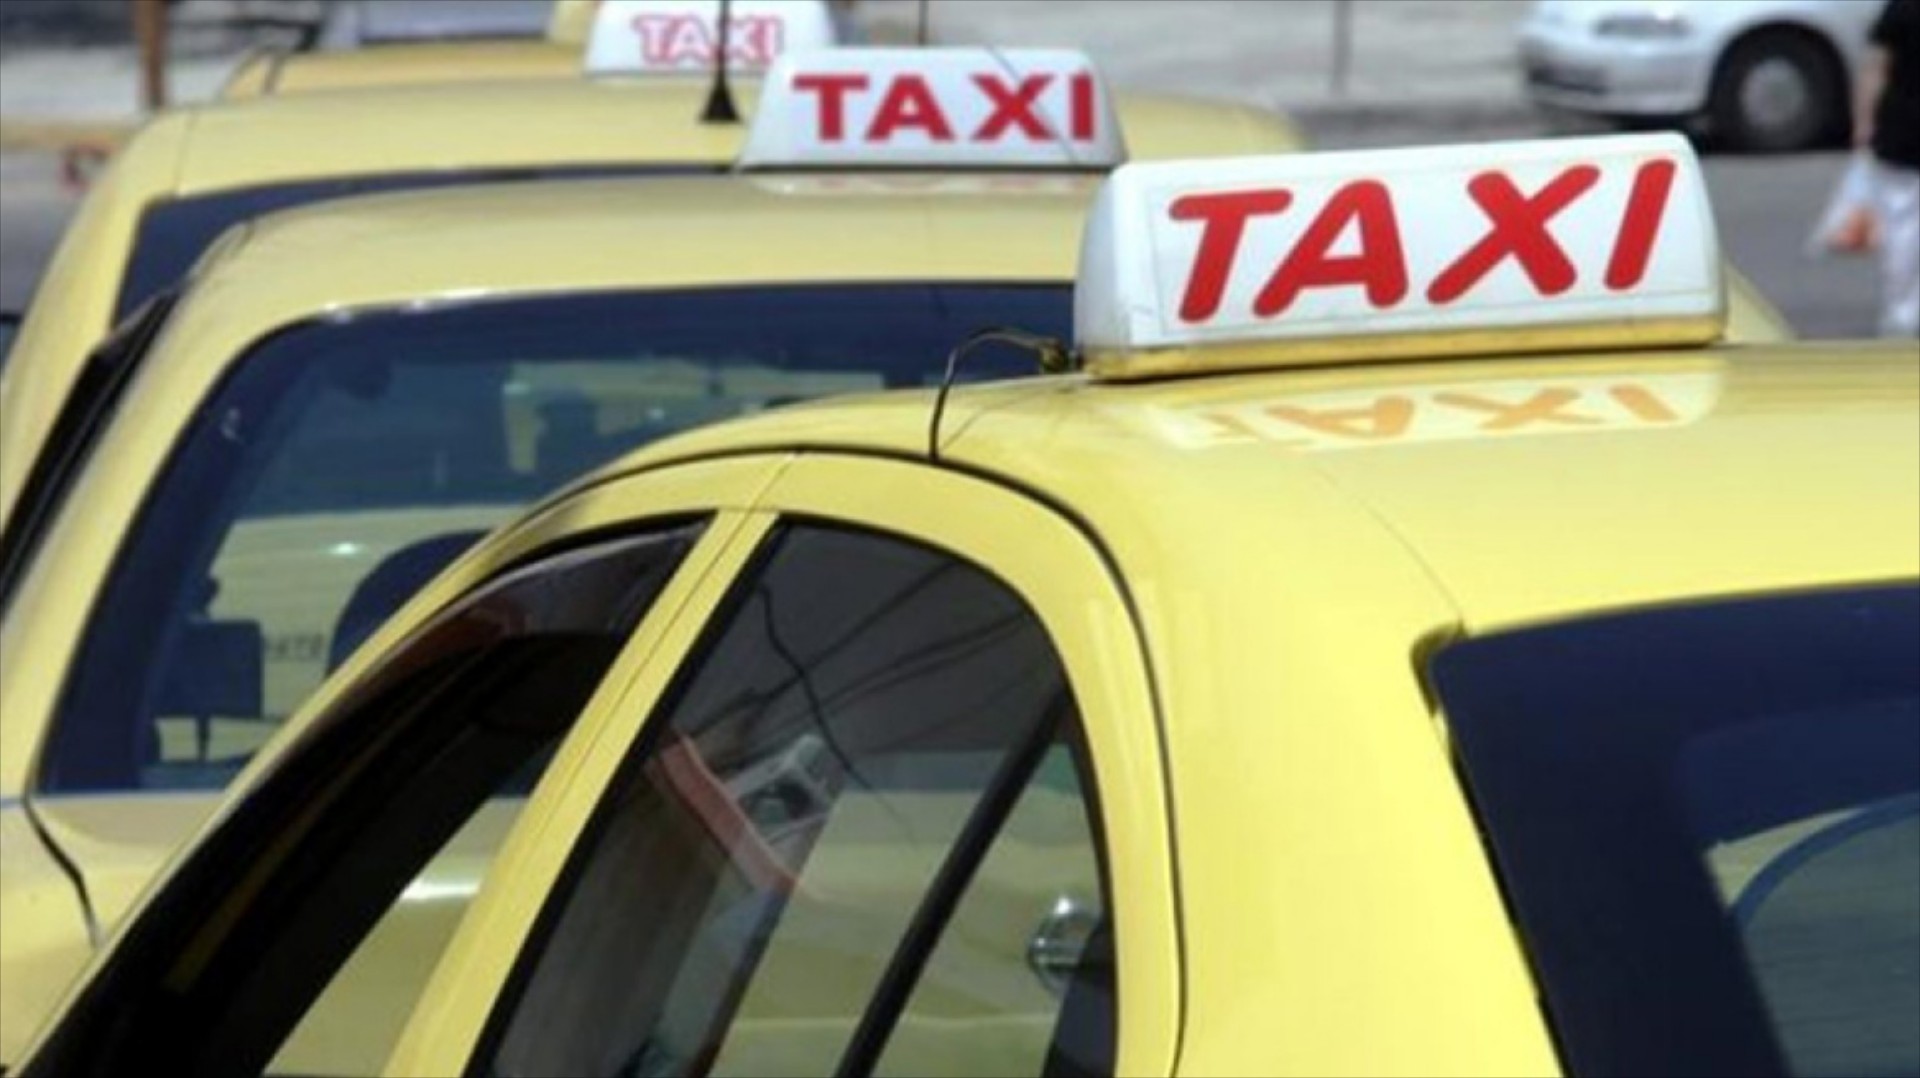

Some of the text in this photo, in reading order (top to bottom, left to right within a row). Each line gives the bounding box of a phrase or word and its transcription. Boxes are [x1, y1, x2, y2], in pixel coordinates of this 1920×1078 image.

[632, 14, 783, 64] TAXI
[792, 72, 1095, 142] TAXI
[1167, 158, 1677, 323] TAXI
